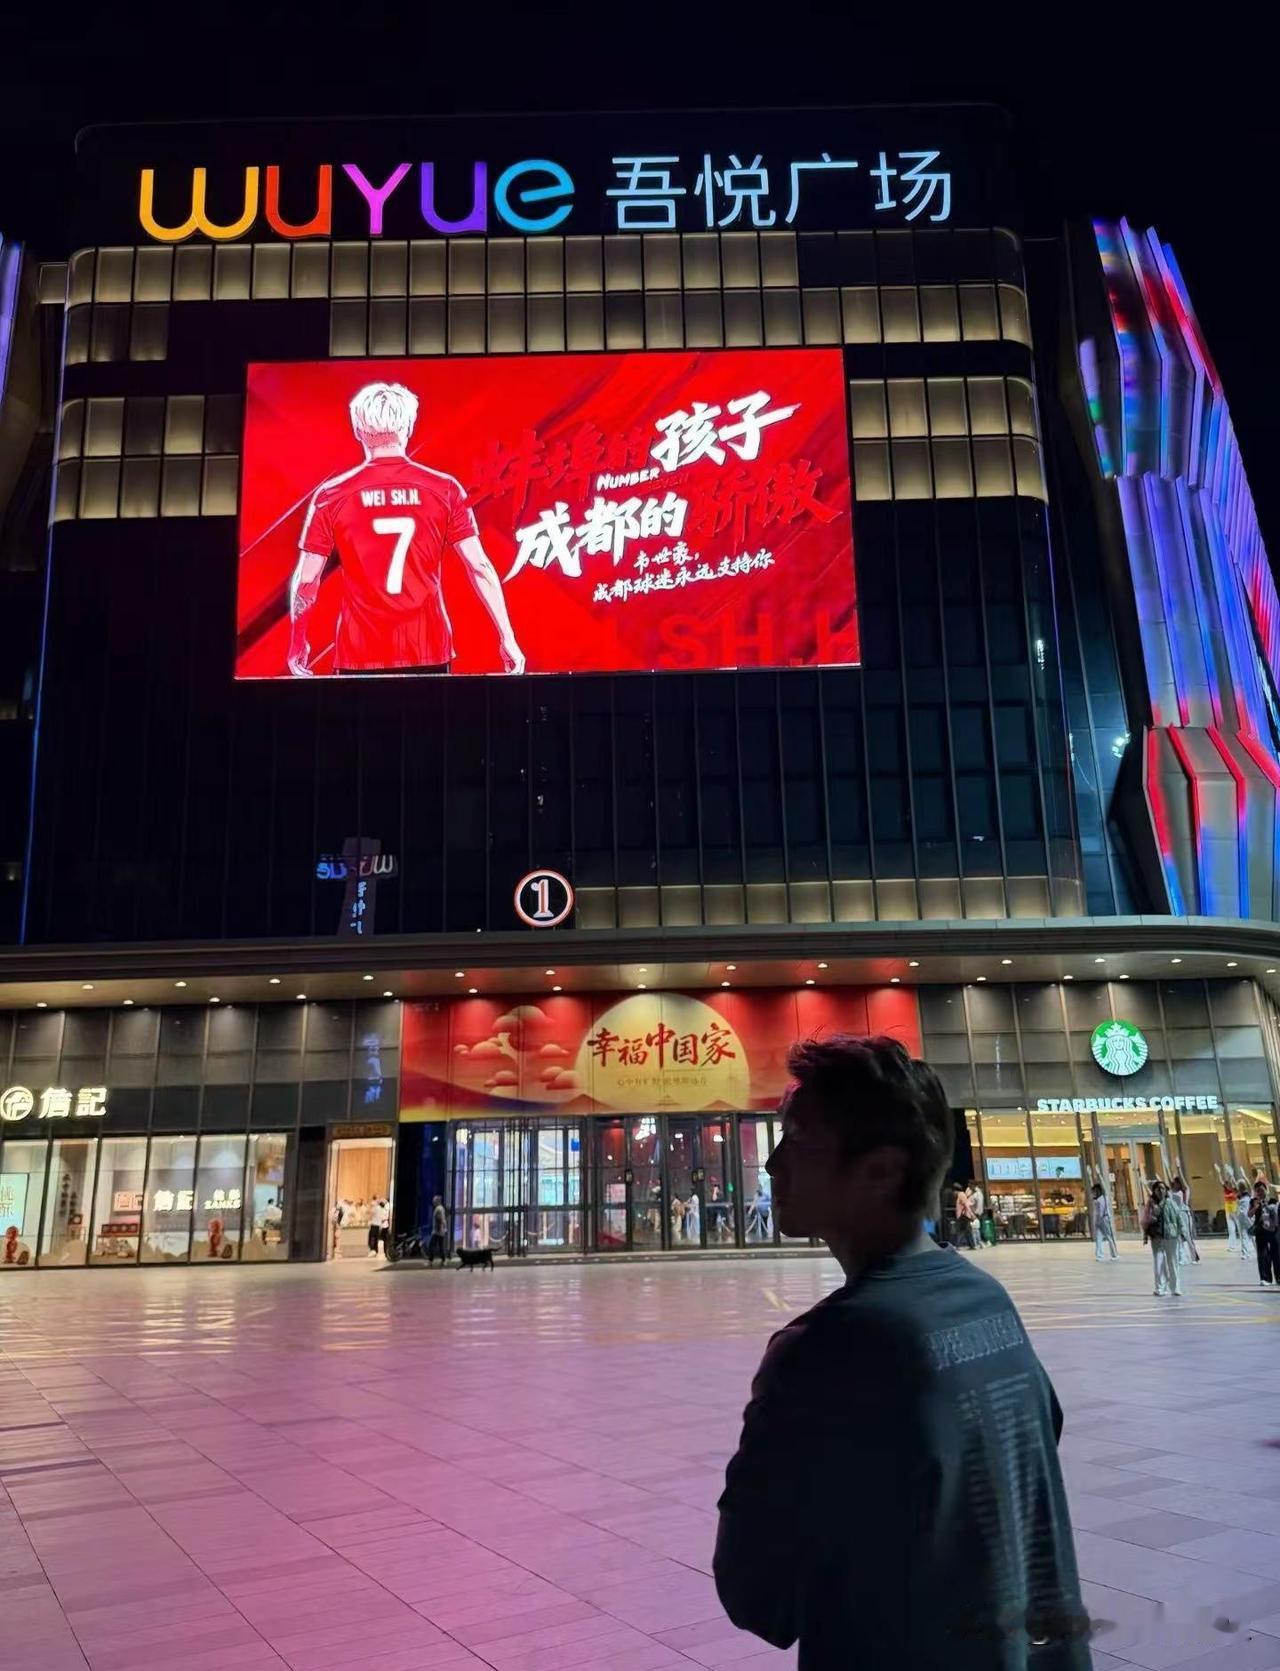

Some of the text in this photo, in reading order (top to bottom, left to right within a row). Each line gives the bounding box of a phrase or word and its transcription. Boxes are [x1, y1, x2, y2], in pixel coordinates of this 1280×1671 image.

[606, 151, 950, 229] 吾悦广场
[361, 489, 386, 507] WEI
[596, 467, 660, 491] NUMBER
[372, 517, 416, 595] 7
[593, 548, 775, 602] 成都球迷永远支持你
[590, 1022, 736, 1069] 幸福中国家
[1037, 1095, 1217, 1113] STARBUCKS COFFEE
